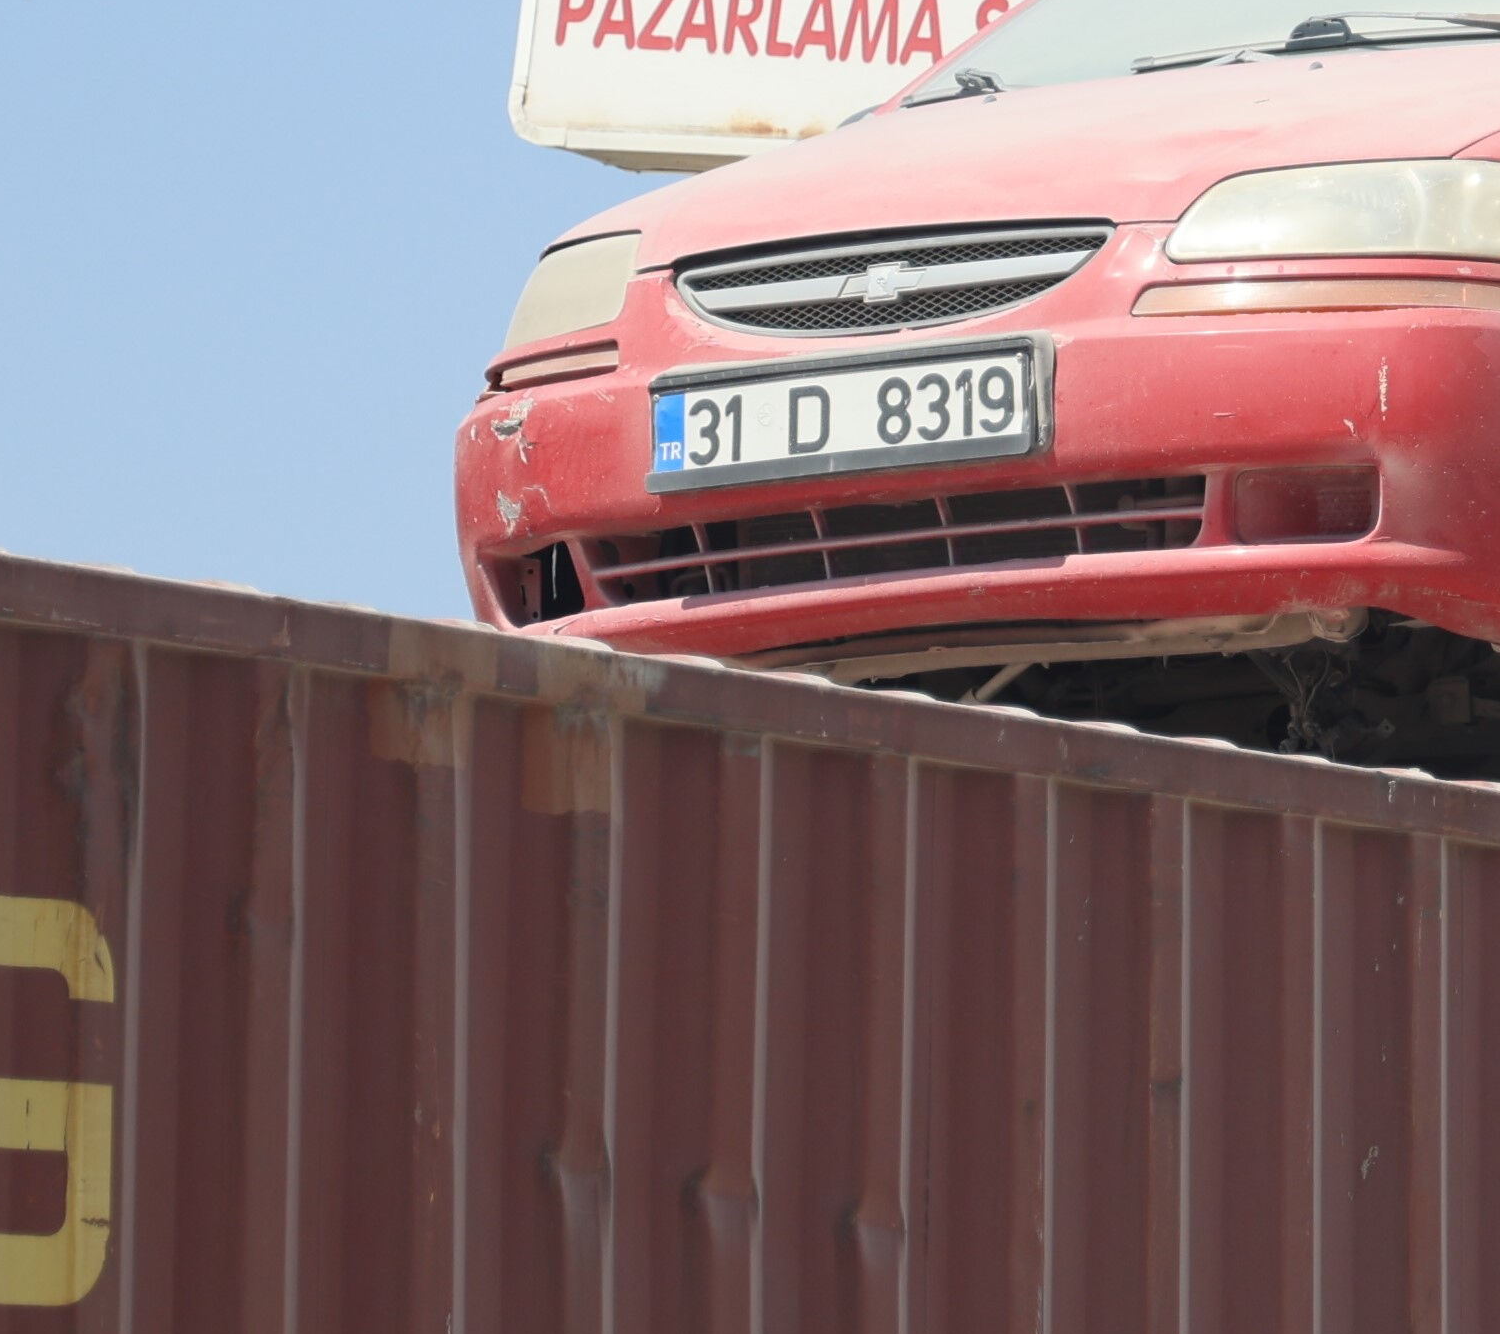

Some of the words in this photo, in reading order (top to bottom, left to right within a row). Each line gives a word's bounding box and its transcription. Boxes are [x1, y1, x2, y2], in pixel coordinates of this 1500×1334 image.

[659, 442, 682, 461] TR
[688, 393, 743, 466] 31
[788, 385, 831, 456] D
[876, 365, 1016, 446] 8319
